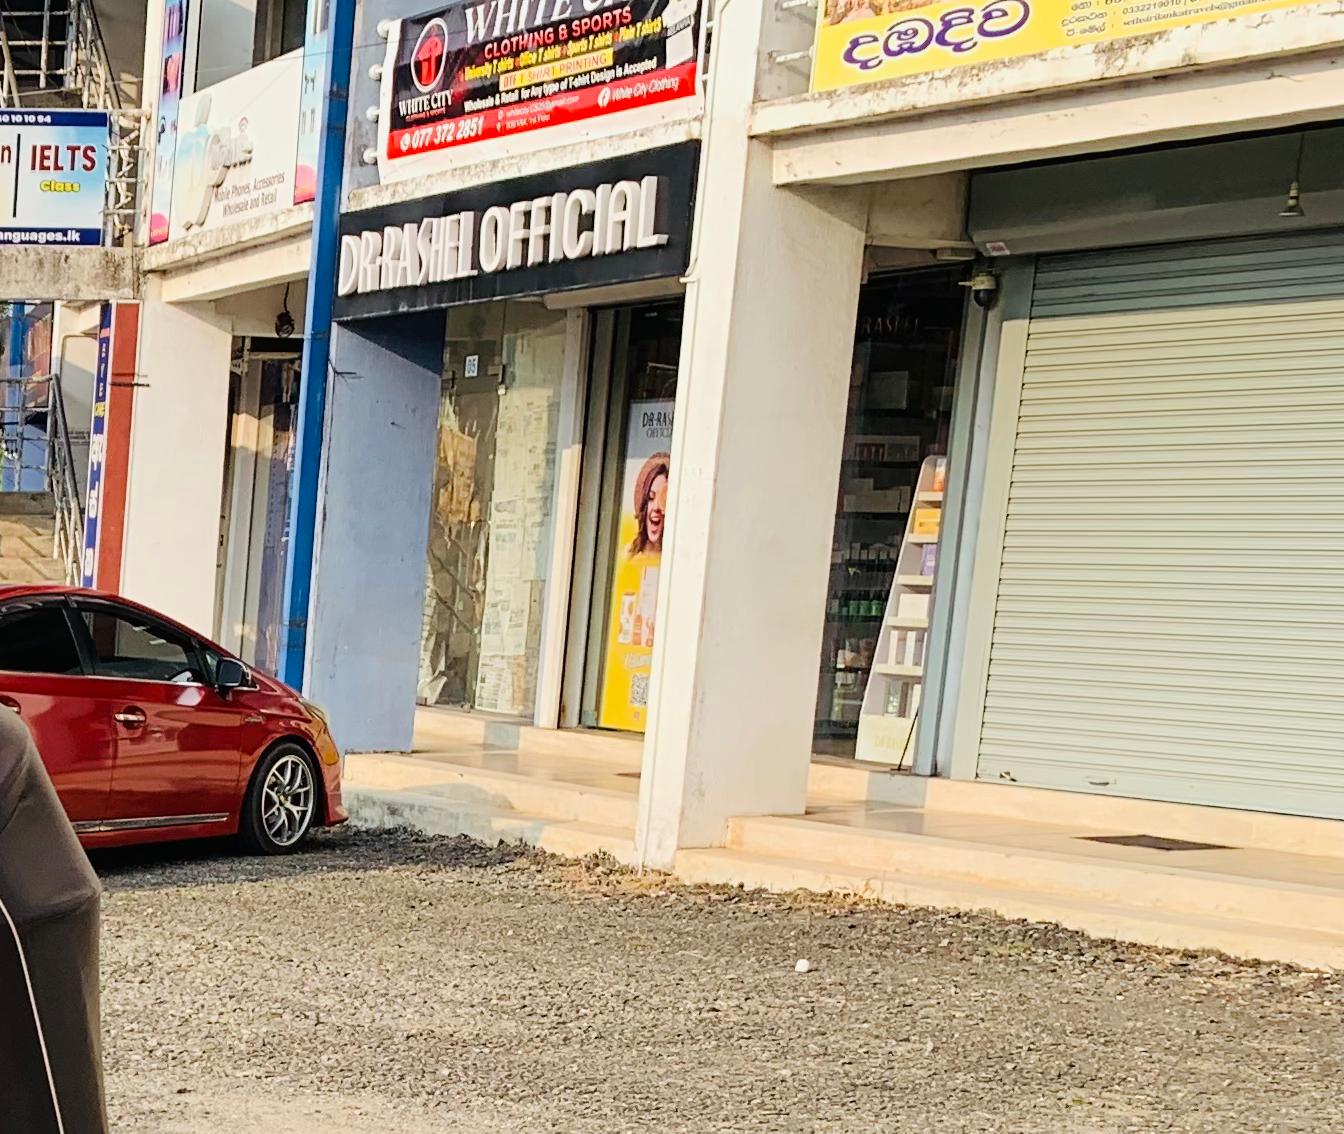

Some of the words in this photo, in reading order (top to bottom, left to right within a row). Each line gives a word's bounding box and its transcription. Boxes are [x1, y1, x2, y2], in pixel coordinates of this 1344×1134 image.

[484, 27, 553, 59] CLOTHING
[558, 24, 568, 40] &
[571, 6, 632, 36] SPORTS
[559, 54, 607, 75] PRINTING
[412, 129, 433, 149] 077
[434, 123, 456, 144] 372
[456, 116, 485, 139] 2851
[31, 145, 96, 172] IELTS
[40, 180, 81, 192] Class
[479, 176, 669, 273] OFFICIAL
